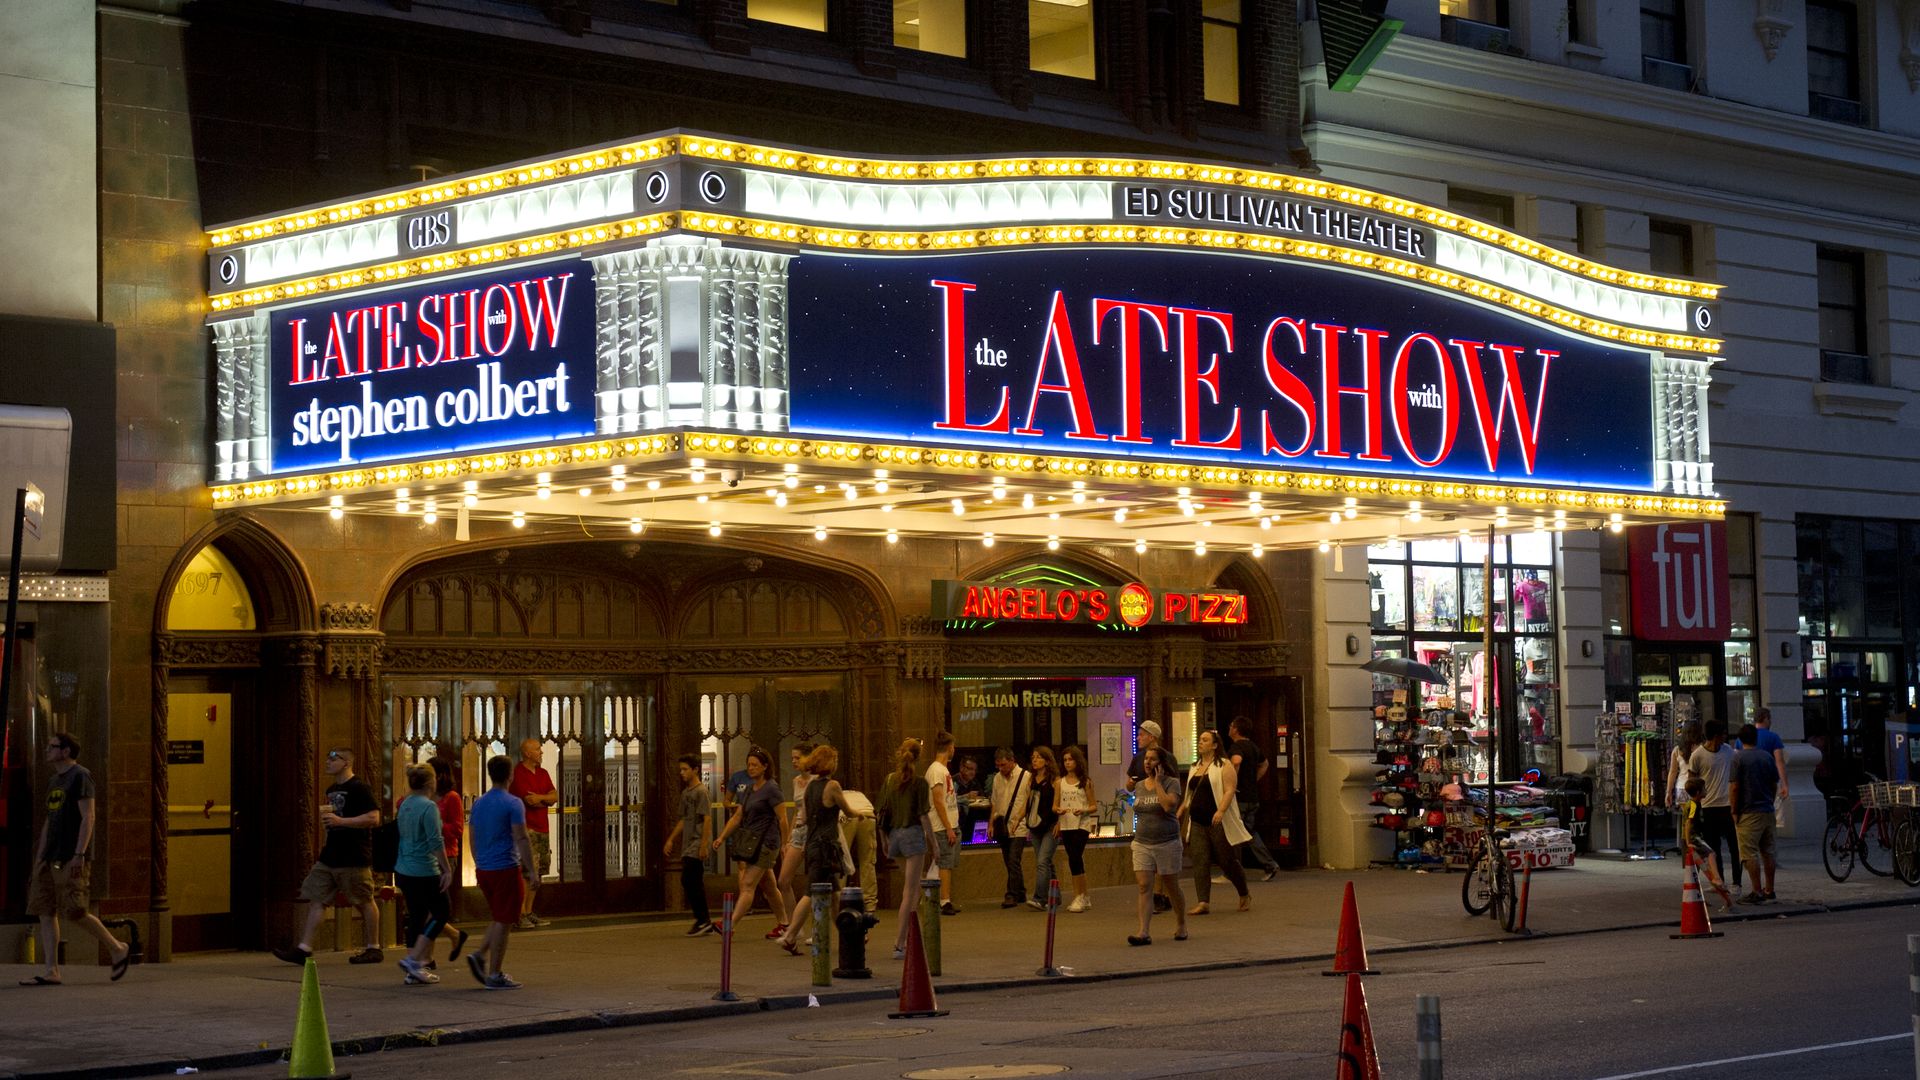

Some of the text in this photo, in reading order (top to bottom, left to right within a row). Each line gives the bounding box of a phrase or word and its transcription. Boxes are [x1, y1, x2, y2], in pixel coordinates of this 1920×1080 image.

[406, 211, 450, 250] CBS
[1123, 186, 1426, 259] ED SULLIVAN THEATER
[288, 272, 574, 385] the LATE SHOW with
[931, 279, 1561, 475] the LATE SHOW with
[292, 361, 571, 462] stephen colbert
[962, 585, 1110, 621] ANGELO'S
[1120, 593, 1147, 604] COAL
[963, 690, 1114, 708] ITALIAN RESTAURANT
[1895, 734, 1904, 749] P
[1569, 822, 1587, 837] NY
[1570, 806, 1576, 821] I
